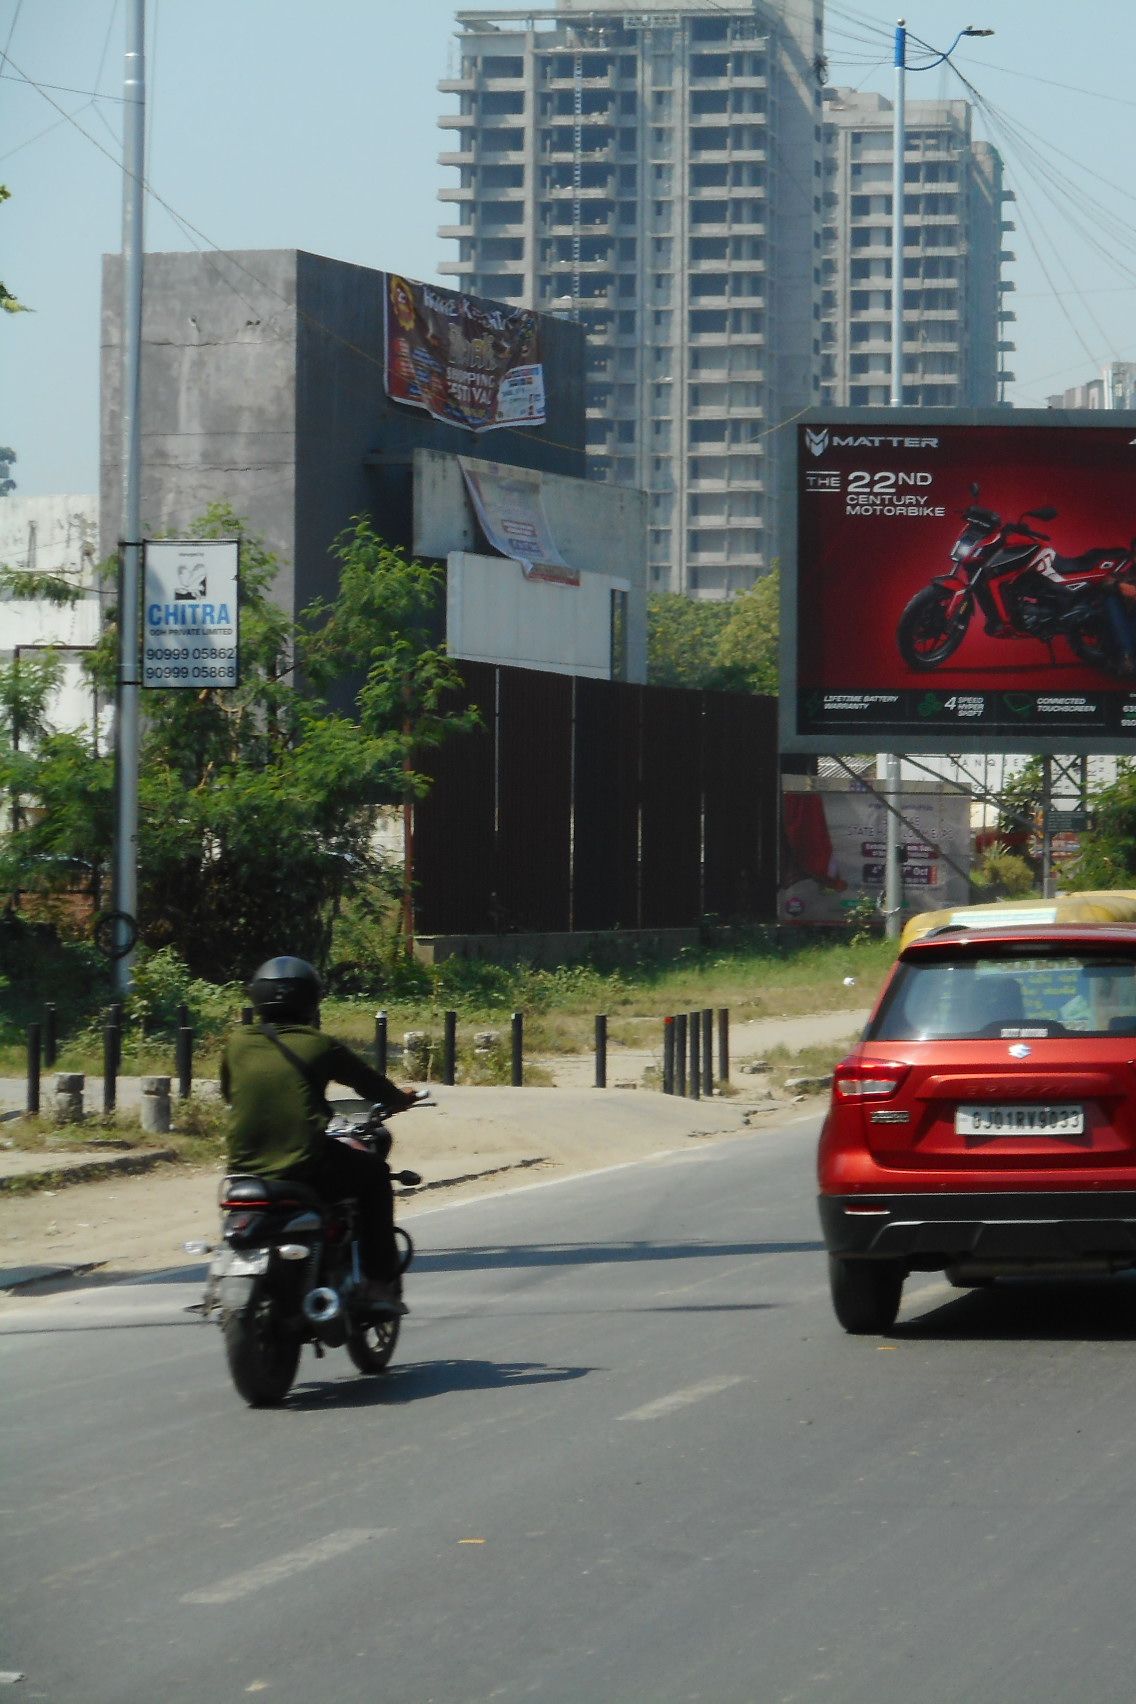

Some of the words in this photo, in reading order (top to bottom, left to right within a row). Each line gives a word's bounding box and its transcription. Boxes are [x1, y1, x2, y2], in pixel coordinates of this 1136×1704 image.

[832, 436, 939, 448] MATTER
[806, 476, 841, 487] THE
[846, 495, 928, 505] CENTURY
[845, 505, 946, 517] MOTORBIKE
[147, 604, 230, 625] CHITRA
[201, 628, 233, 636] LIMITED
[146, 648, 190, 660] 90999
[192, 648, 235, 660] 05862
[146, 667, 189, 678] 90999
[192, 666, 235, 678] 05868
[944, 696, 957, 711] 4
